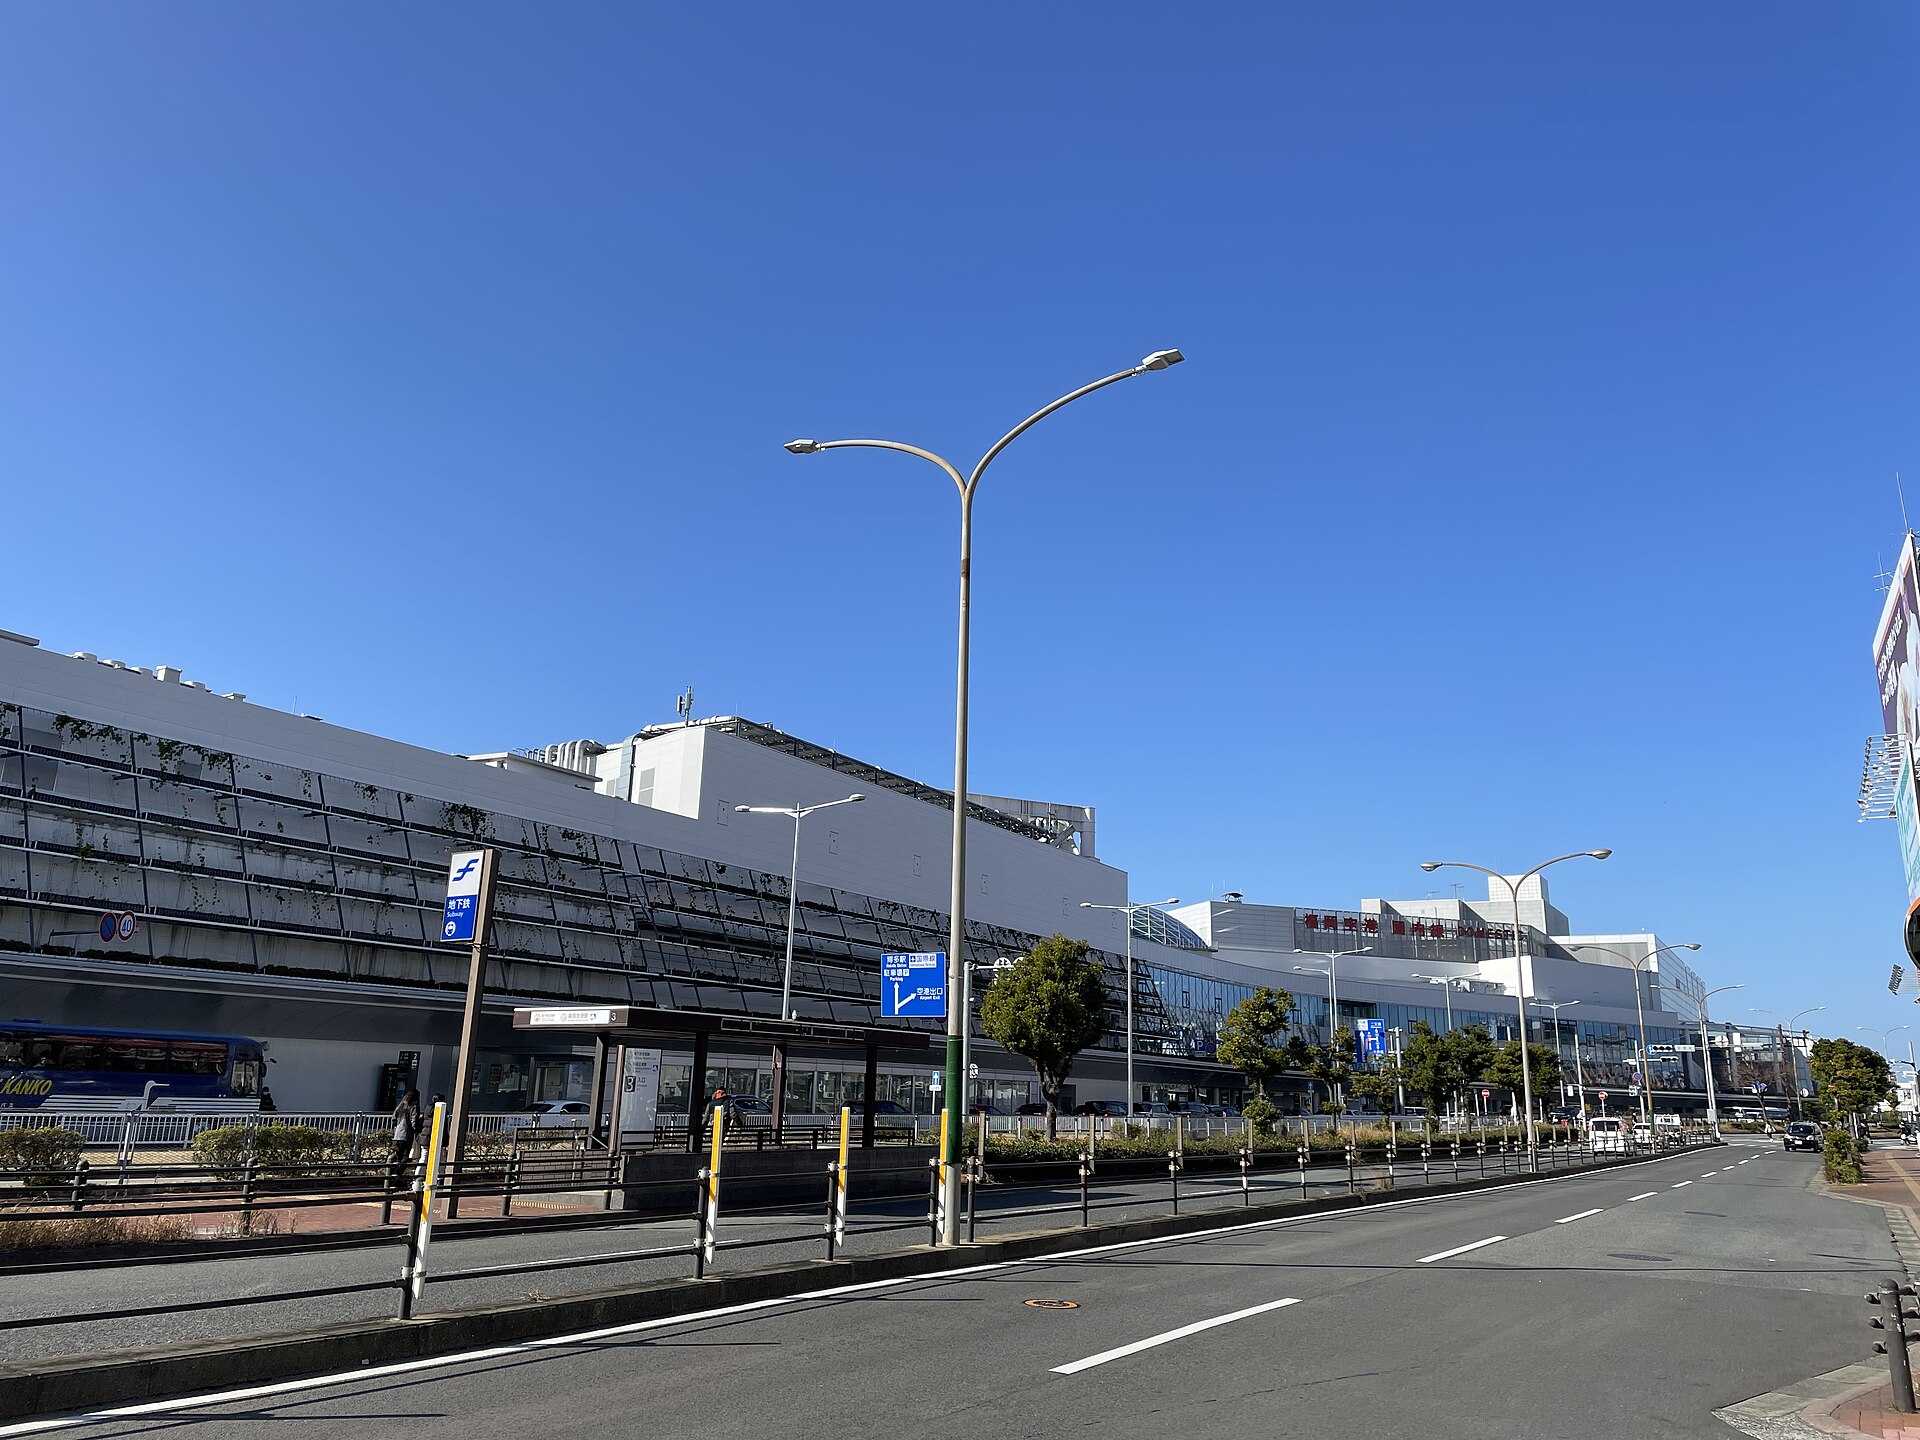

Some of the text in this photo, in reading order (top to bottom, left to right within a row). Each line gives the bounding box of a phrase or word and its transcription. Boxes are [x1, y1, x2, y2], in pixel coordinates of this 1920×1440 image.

[447, 898, 471, 910] 地下鉄
[122, 919, 132, 933] 40
[611, 1012, 617, 1022] 3
[413, 1052, 418, 1060] 2
[0, 1078, 53, 1096] KANKO
[626, 1076, 634, 1092] 3
